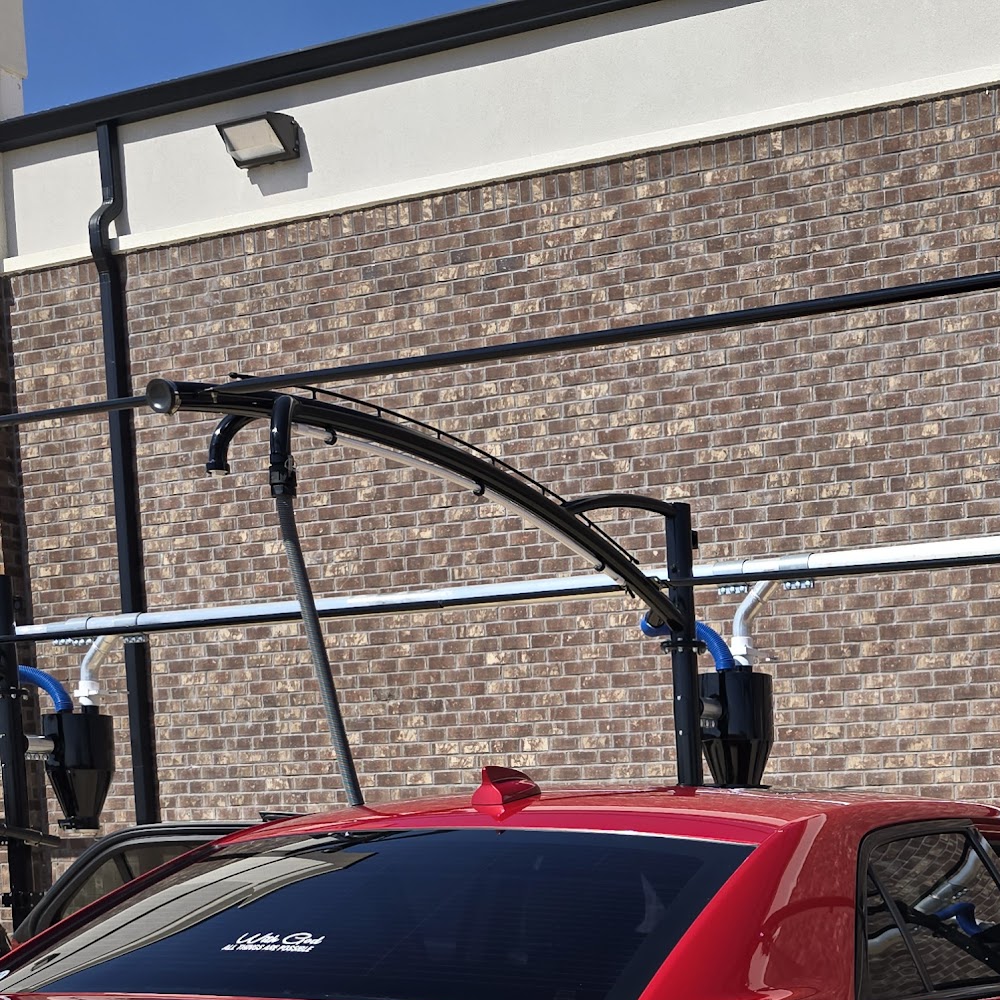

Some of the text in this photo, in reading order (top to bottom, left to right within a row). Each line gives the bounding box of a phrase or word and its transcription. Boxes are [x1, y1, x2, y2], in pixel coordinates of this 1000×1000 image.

[236, 932, 326, 945] With God
[277, 945, 315, 953] POSSIBLE
